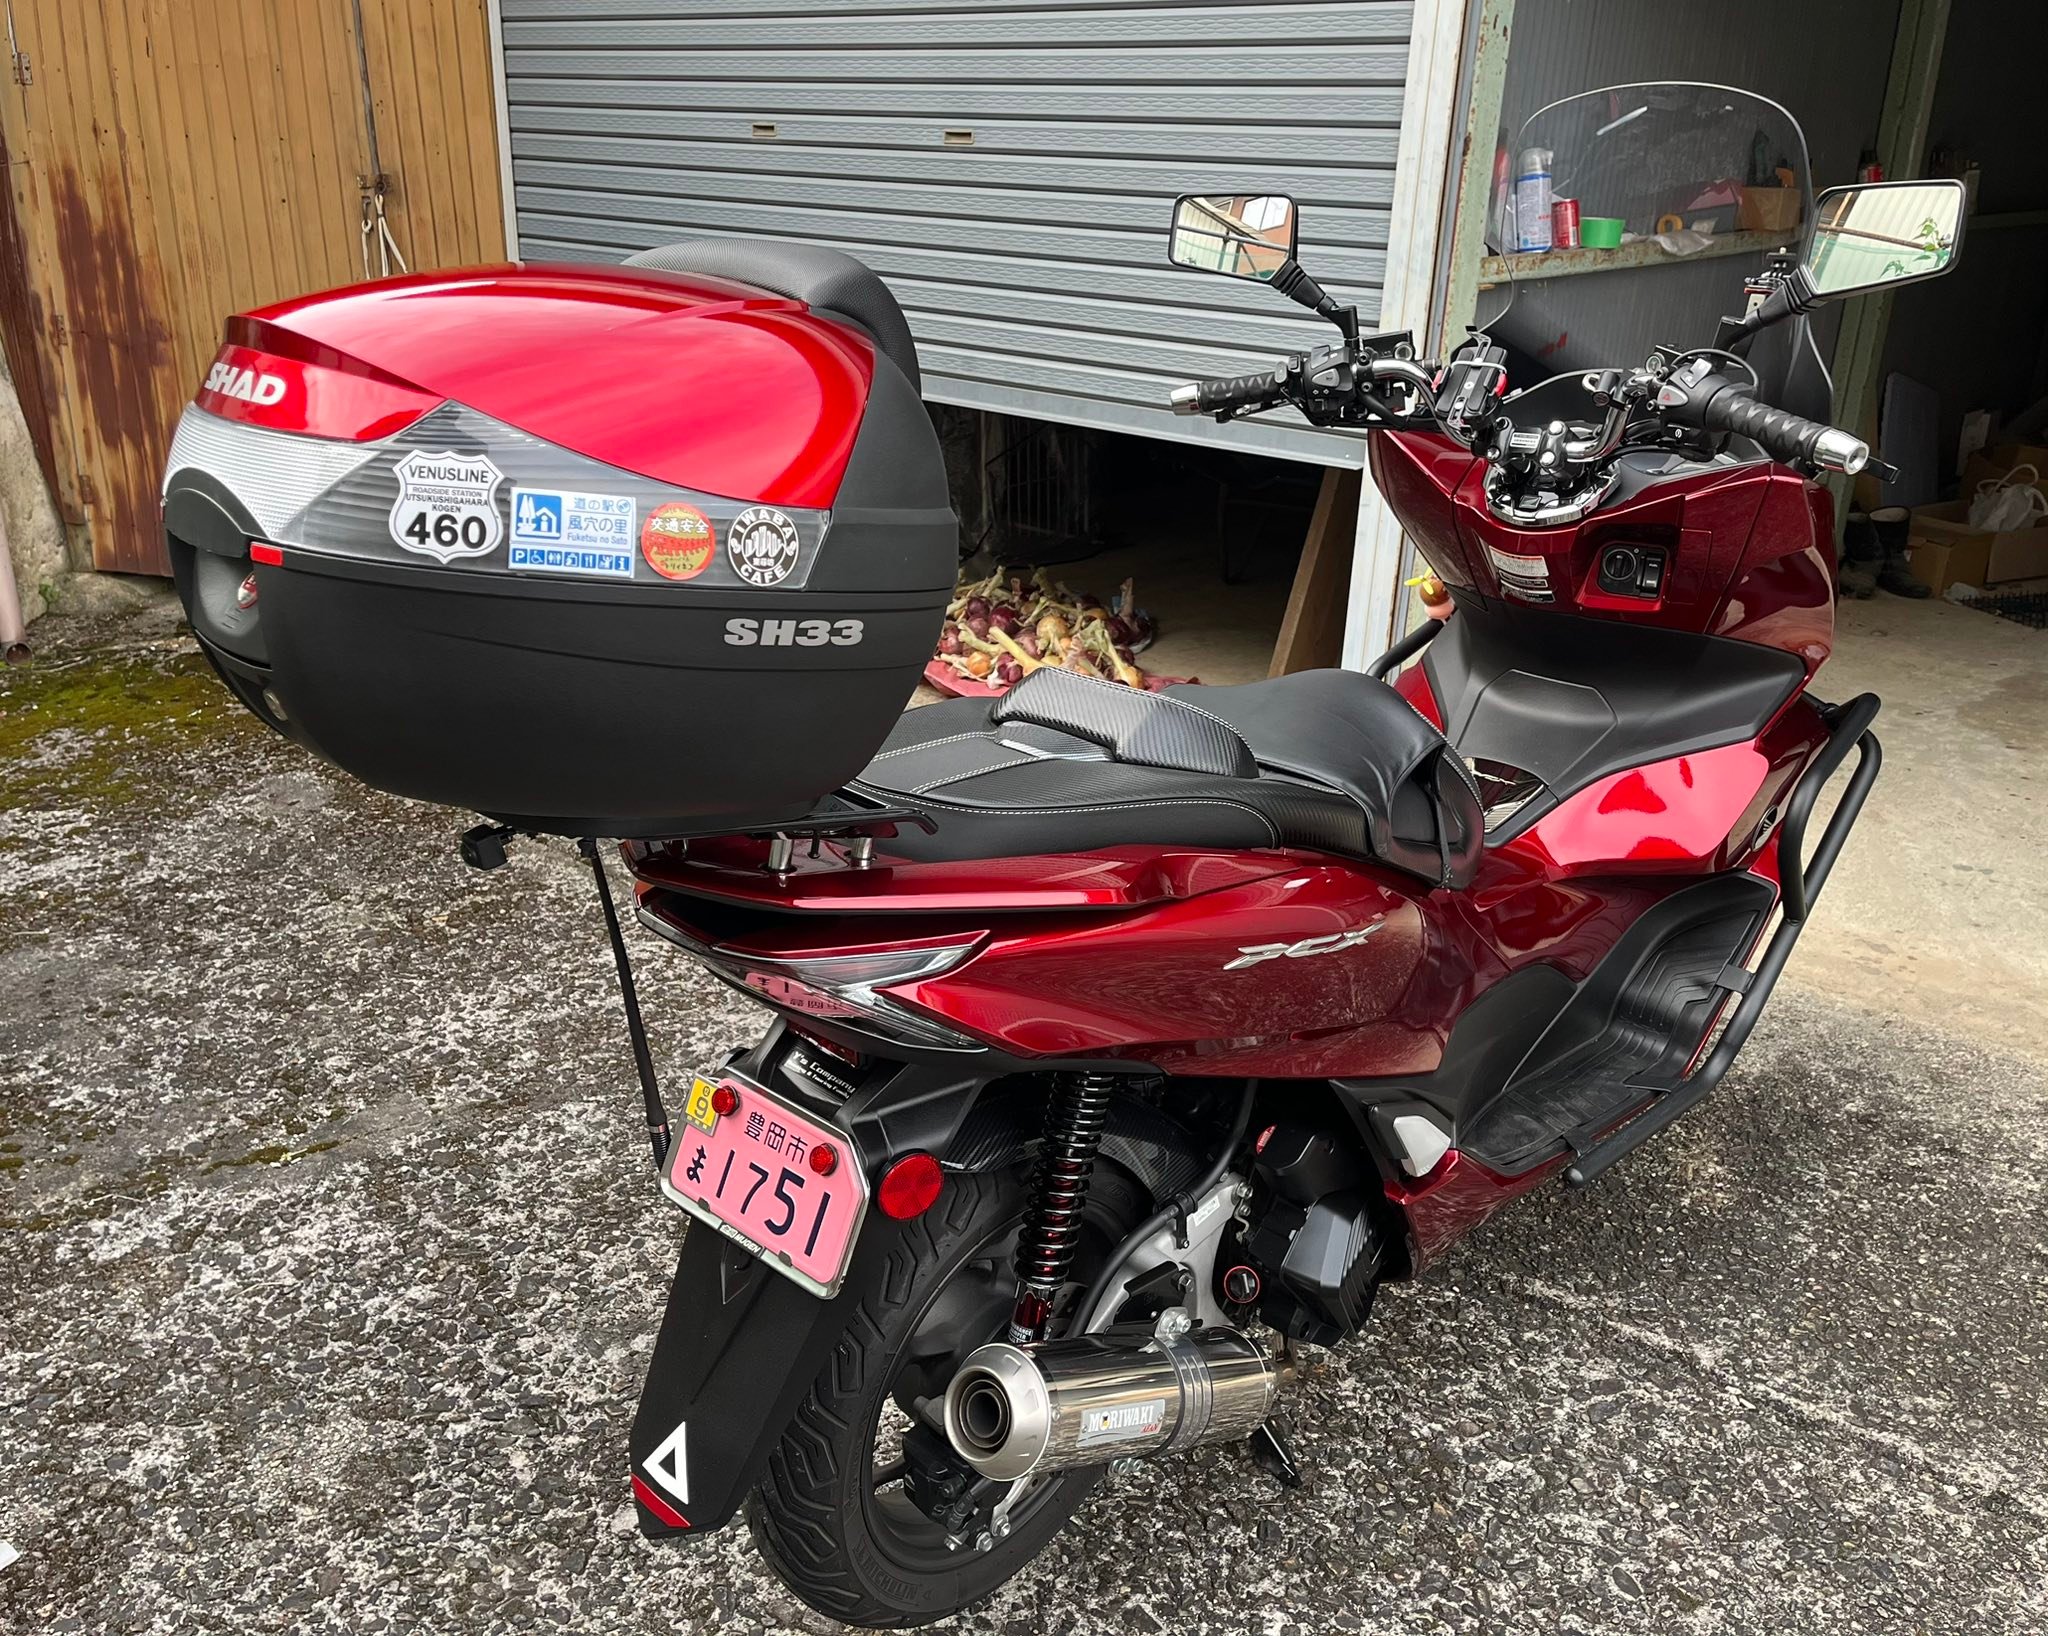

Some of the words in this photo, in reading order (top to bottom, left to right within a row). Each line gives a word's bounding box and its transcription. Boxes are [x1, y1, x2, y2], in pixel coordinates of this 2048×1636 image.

[204, 362, 286, 405] SHAD
[408, 464, 489, 484] VENUSLINE
[405, 494, 488, 507] UTSUKUSHIGAHARA
[412, 487, 449, 496] ROADSIDE
[451, 489, 483, 498] STATION
[432, 504, 461, 513] KOGEN
[574, 497, 615, 513] 道の駅
[405, 511, 487, 549] 460
[567, 514, 628, 535] 風穴の里
[650, 516, 709, 534] 交通安全
[735, 508, 794, 540] IWABA
[567, 532, 598, 544] Fuketsu
[599, 536, 609, 544] no
[610, 536, 628, 545] Sato
[740, 563, 786, 584] CAFE
[724, 618, 864, 647] SH33
[746, 1110, 809, 1165] 豊岡市
[686, 1145, 706, 1184] ま
[715, 1149, 831, 1257] 1751
[733, 1233, 761, 1253] MUGEN
[1088, 1405, 1154, 1432] MORIWAKI
